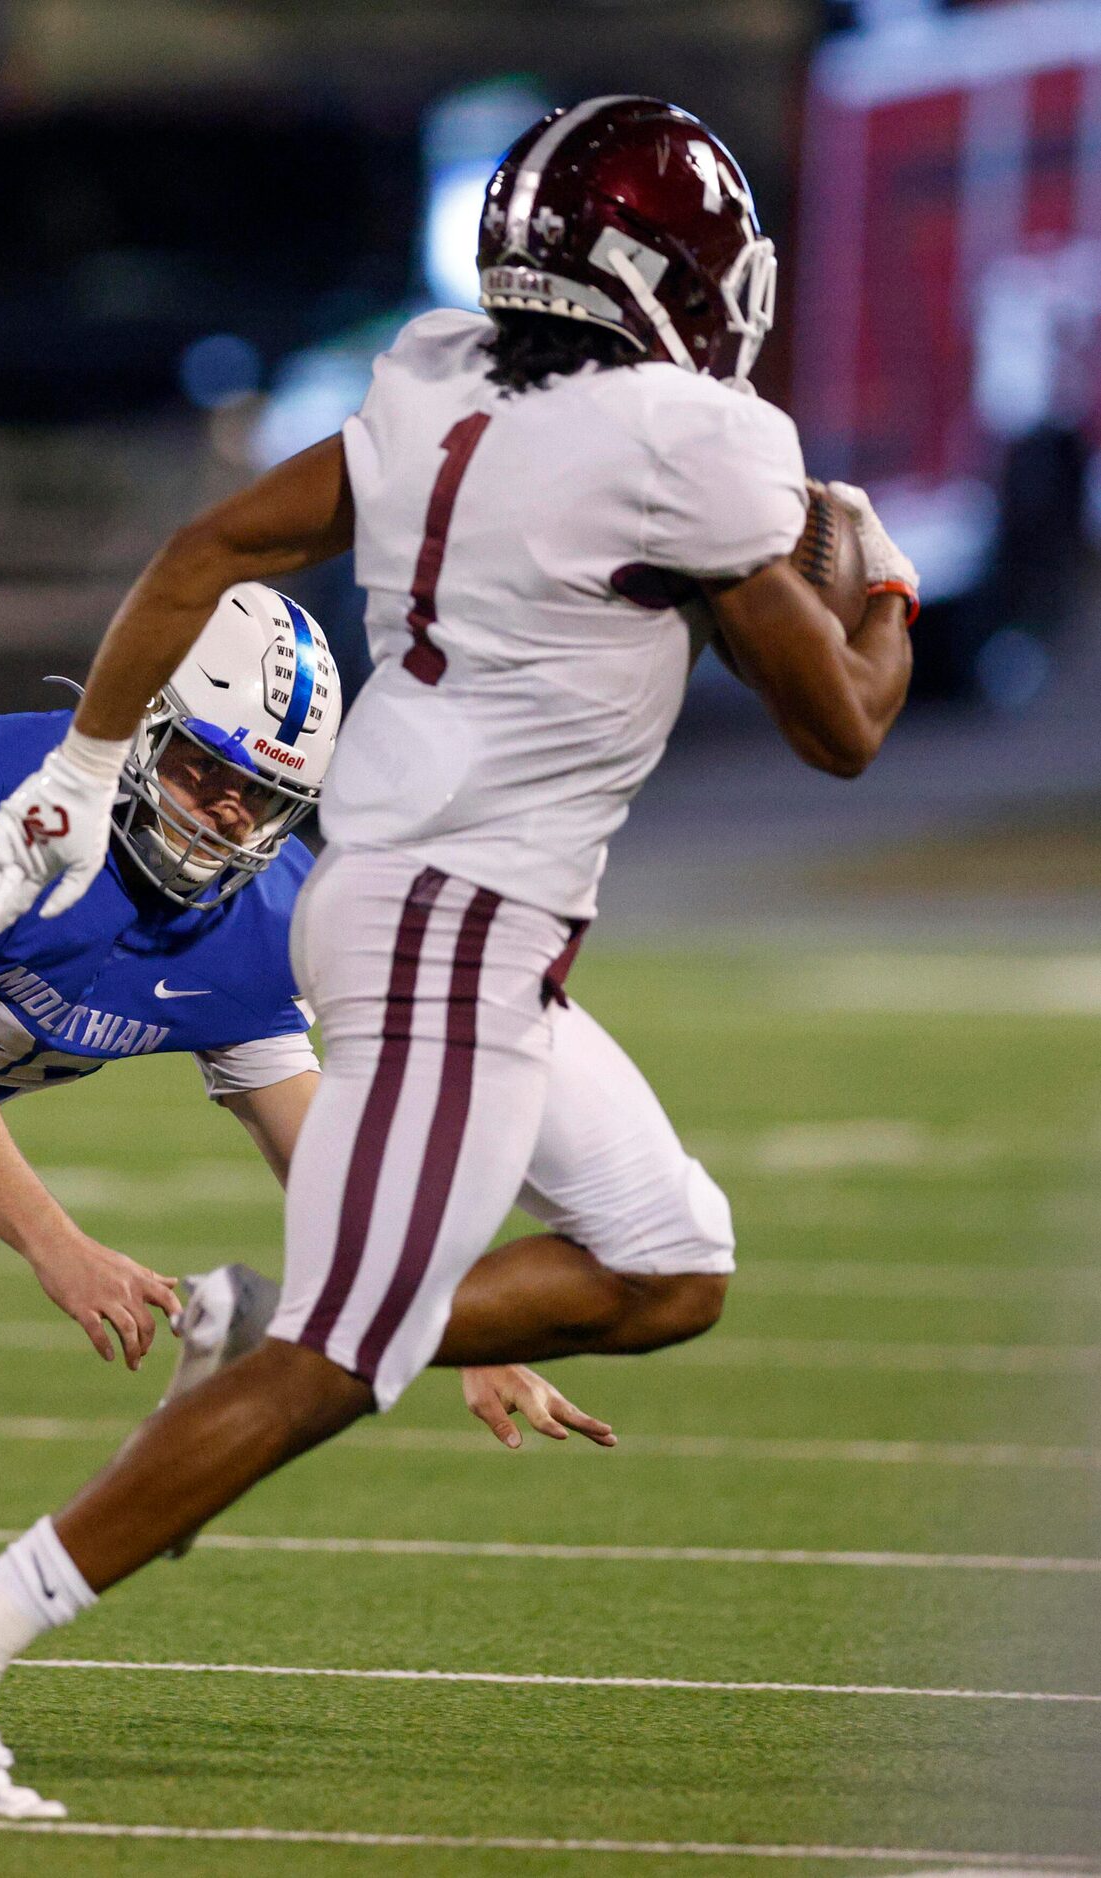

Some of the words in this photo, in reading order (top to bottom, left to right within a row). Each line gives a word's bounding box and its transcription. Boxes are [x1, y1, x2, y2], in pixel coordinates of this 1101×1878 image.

[401, 410, 492, 687] 1
[272, 618, 290, 629] WIN
[277, 645, 294, 658] WIN
[275, 666, 292, 680] WIN
[317, 661, 328, 676] WIN
[271, 688, 289, 704] WIN
[316, 683, 327, 698] WIN
[309, 705, 323, 720] WIN
[253, 739, 305, 770] Riddell
